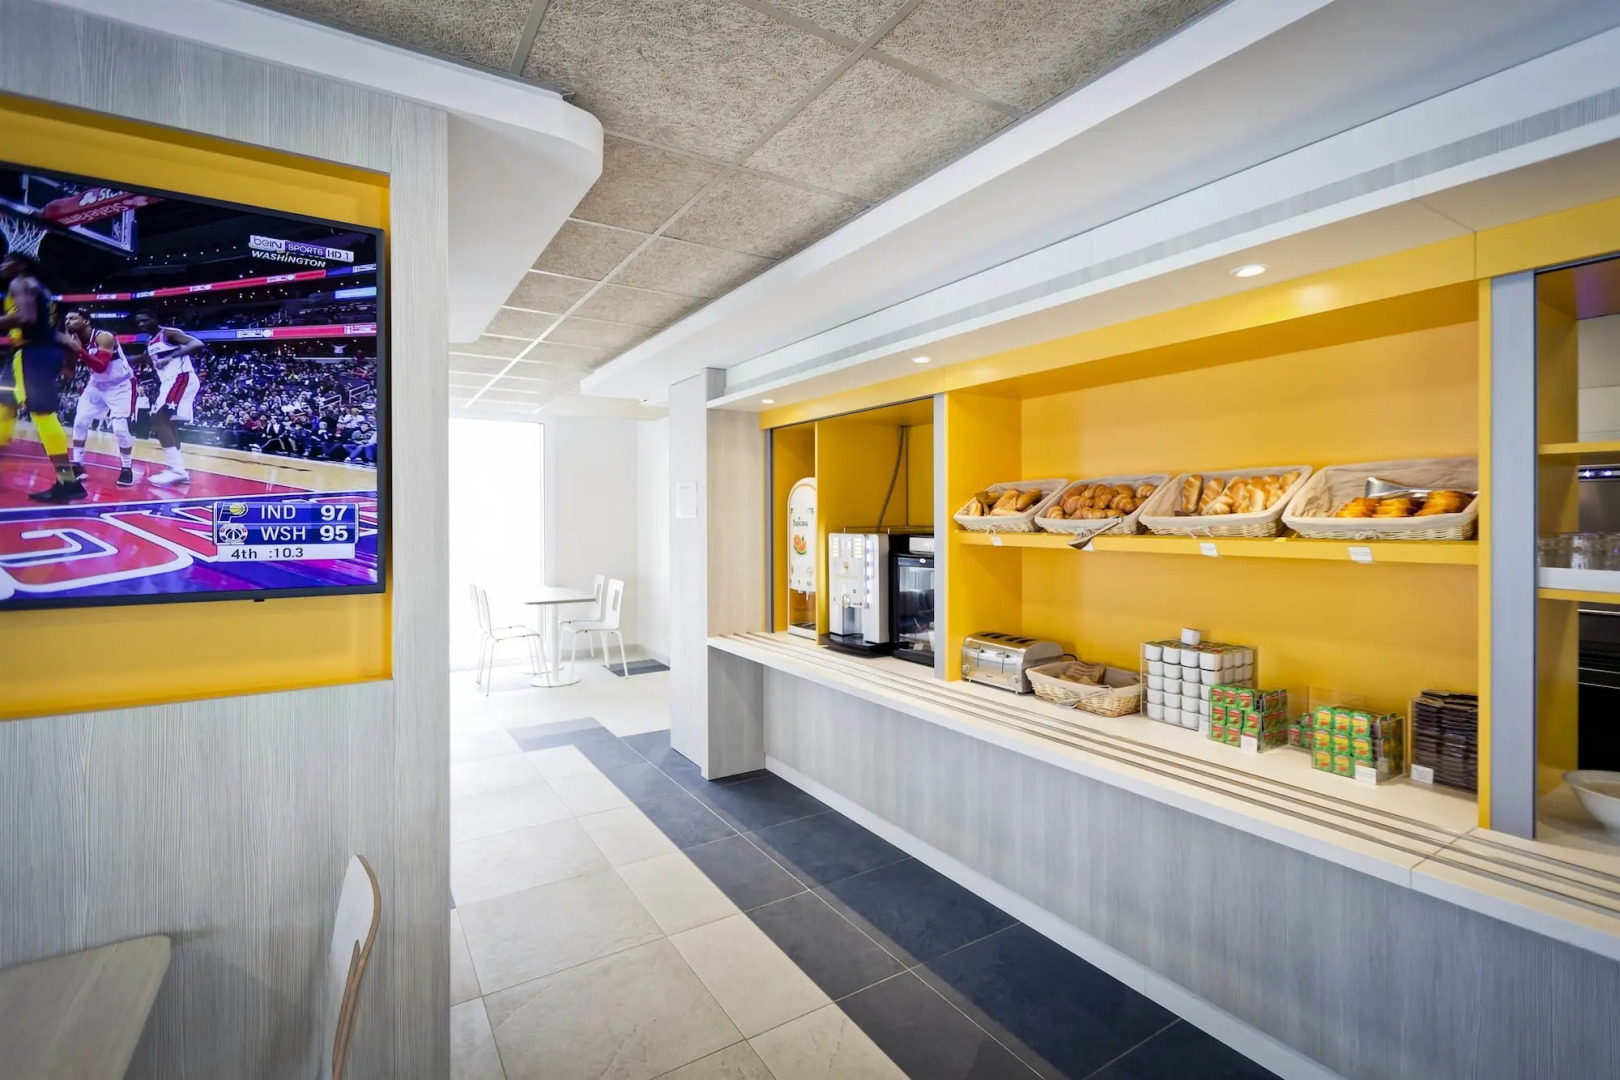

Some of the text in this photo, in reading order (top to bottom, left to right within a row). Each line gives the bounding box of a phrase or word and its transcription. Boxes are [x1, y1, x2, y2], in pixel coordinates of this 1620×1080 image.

[251, 250, 326, 268] WASHINGTON
[288, 243, 323, 256] SPORTS
[327, 250, 342, 259] HD
[261, 505, 348, 521] IND 97
[260, 525, 348, 541] WSH 95
[231, 547, 304, 559] 4th :10.3
